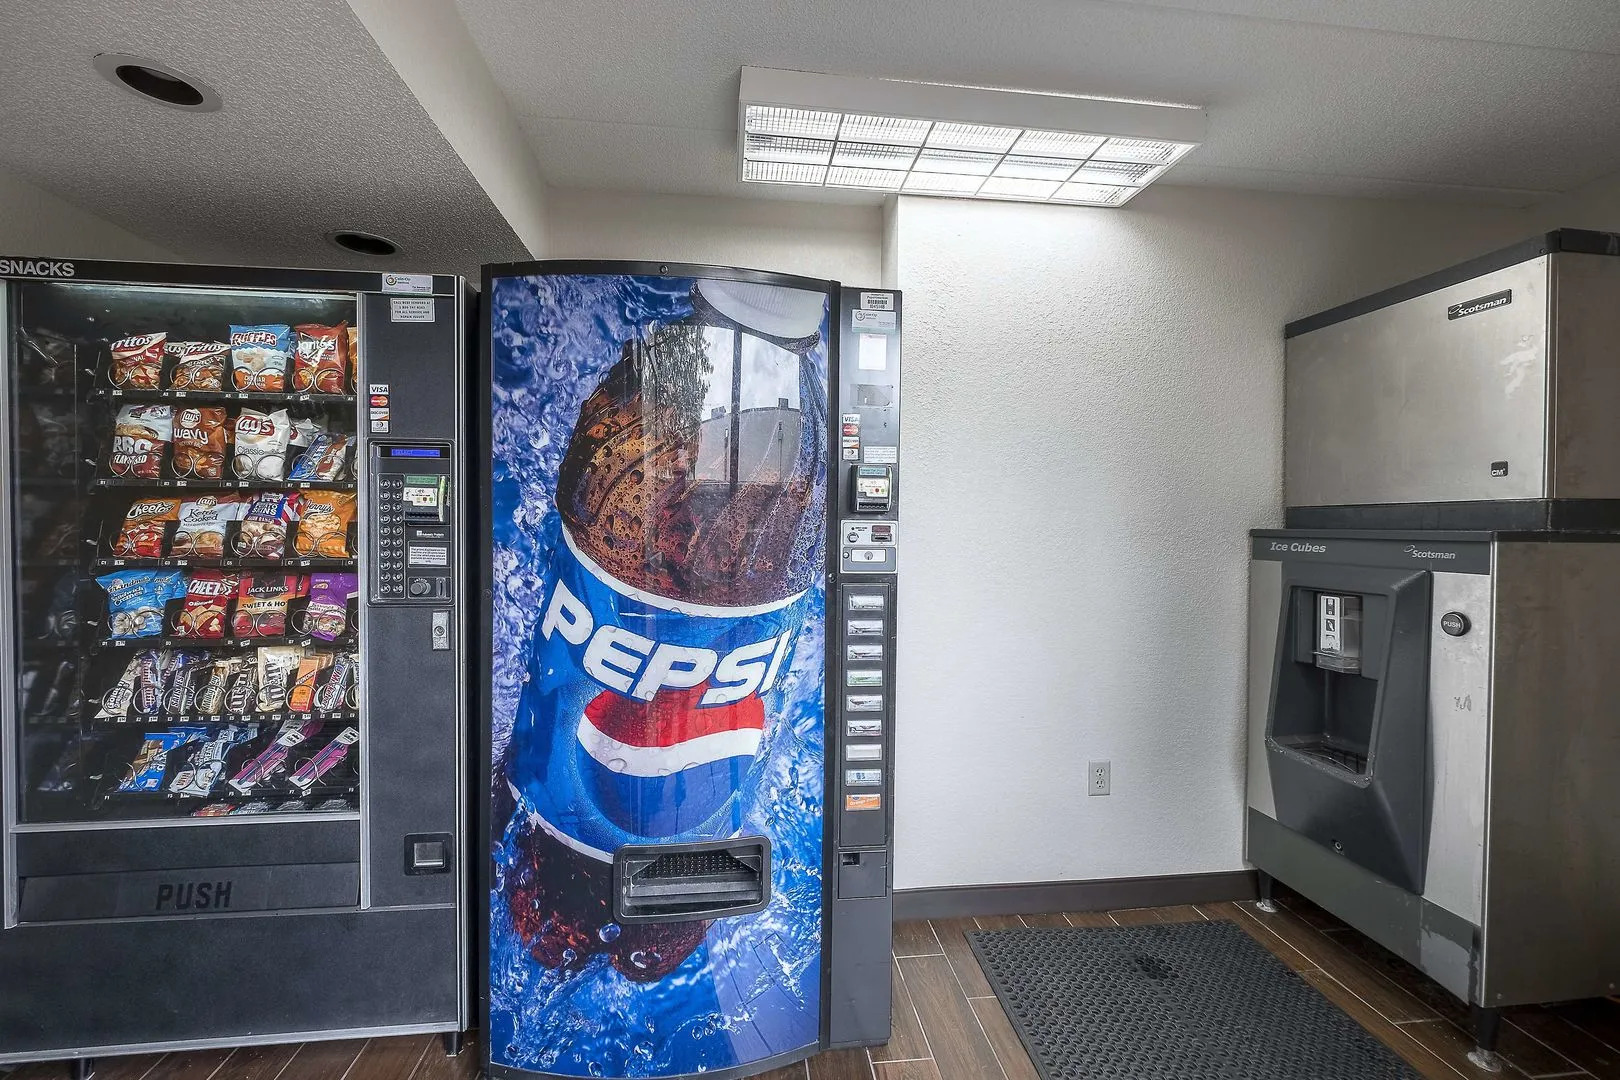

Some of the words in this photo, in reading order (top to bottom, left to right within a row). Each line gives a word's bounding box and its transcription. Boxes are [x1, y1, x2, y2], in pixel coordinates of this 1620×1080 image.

[0, 260, 75, 277] SNACKS
[1458, 298, 1507, 316] Scotsman
[174, 428, 209, 445] wavy
[237, 446, 265, 455] Classic
[126, 501, 175, 519] Cheetos
[184, 513, 219, 523] Cooked
[1270, 542, 1289, 551] Ice
[1290, 542, 1327, 553] Cubes
[1412, 549, 1456, 559] Scotsman
[247, 586, 265, 594] JACK
[1443, 620, 1461, 628] PUSH
[541, 579, 792, 702] PEPSI
[155, 880, 232, 910] PUSH
